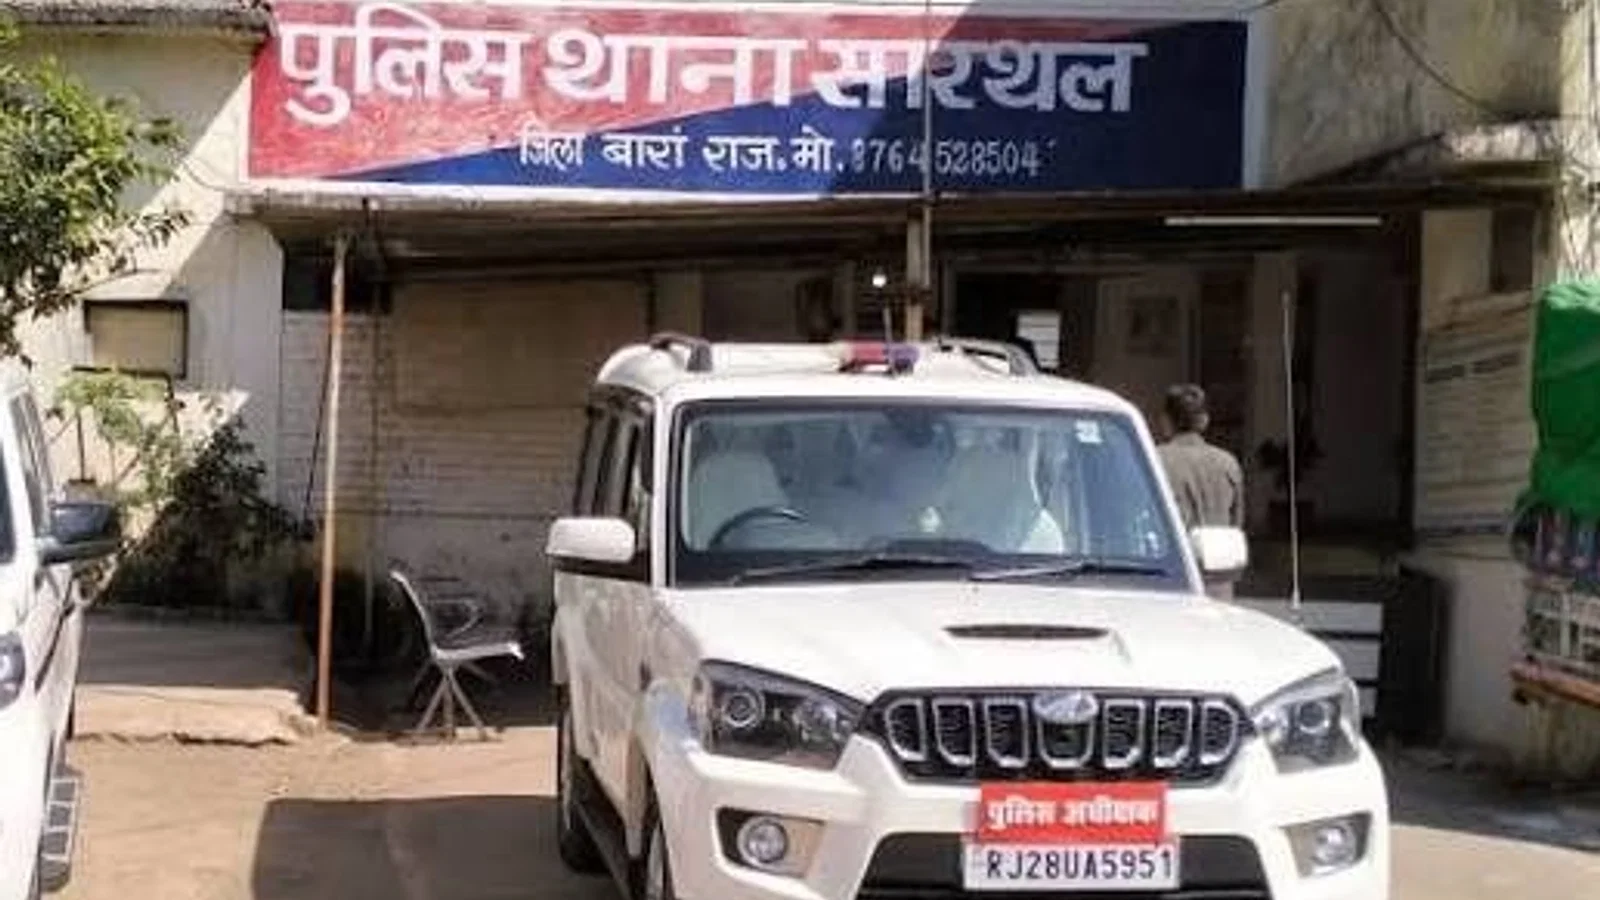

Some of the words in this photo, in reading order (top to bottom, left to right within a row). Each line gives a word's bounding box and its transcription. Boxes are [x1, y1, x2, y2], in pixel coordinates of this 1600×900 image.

[279, 6, 532, 125] पुलिस
[543, 28, 806, 104] थाना
[810, 38, 1148, 112] सारथल
[519, 121, 586, 171] जिला
[600, 126, 688, 171] बारां
[987, 794, 1057, 830] पुलिस
[986, 850, 1172, 880] RJ28UA5951
